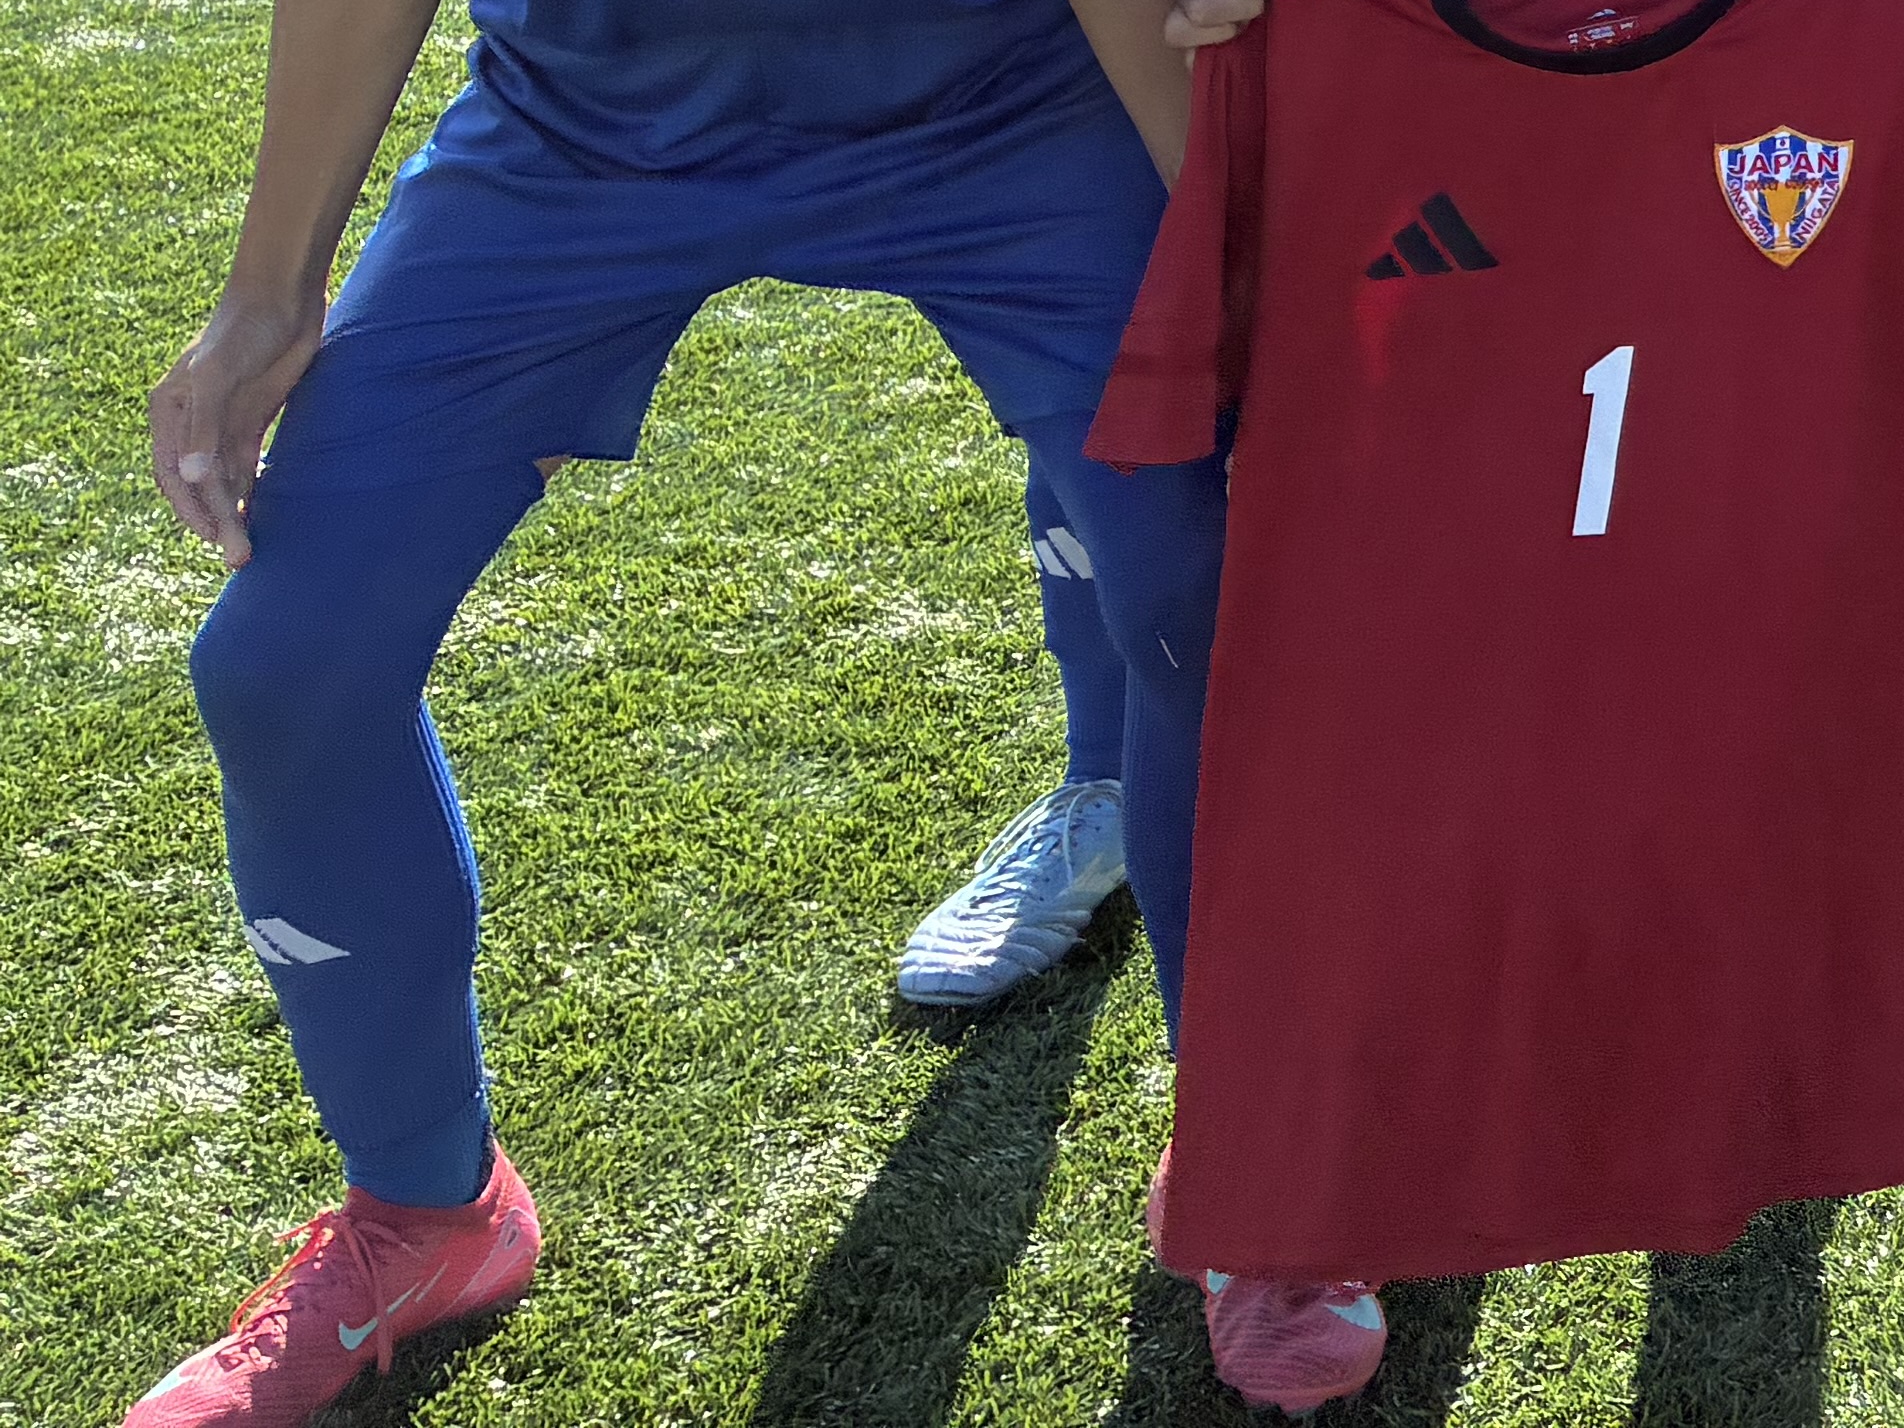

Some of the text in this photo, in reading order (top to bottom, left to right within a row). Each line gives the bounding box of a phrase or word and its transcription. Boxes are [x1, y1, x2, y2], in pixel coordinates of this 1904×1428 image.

[1728, 153, 1839, 175] JAPAN
[1728, 181, 1751, 215] SINCE
[1795, 180, 1839, 242] NIIGATA
[1572, 346, 1635, 537] 1
